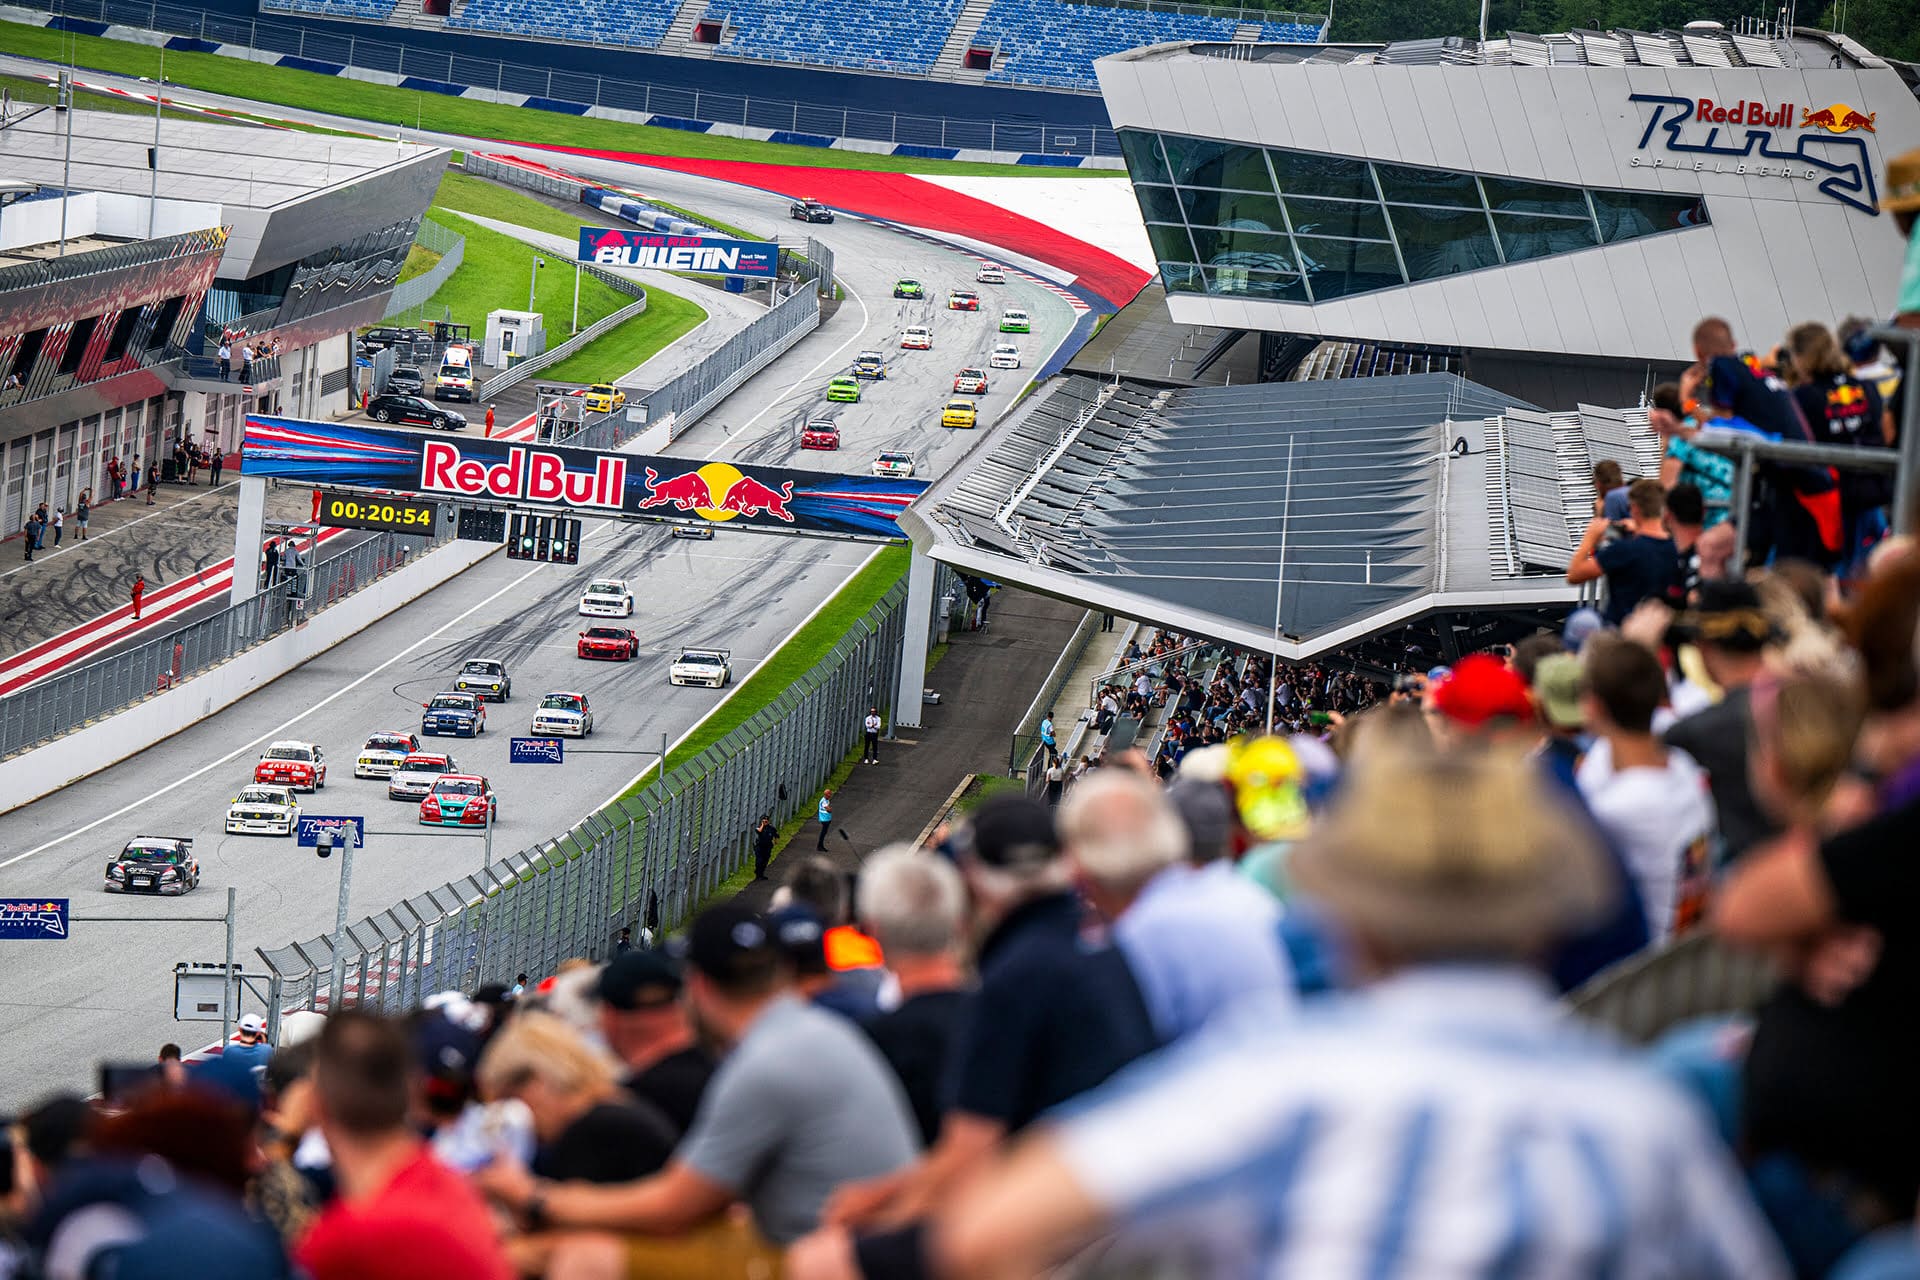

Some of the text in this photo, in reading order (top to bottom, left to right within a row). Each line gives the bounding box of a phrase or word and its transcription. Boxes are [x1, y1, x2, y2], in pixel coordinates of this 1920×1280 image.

[1696, 98, 1794, 128] Red Bull
[1630, 156, 1817, 180] SPIELBERG
[632, 236, 702, 248] THE RED
[421, 440, 627, 509] Red Bull
[331, 501, 431, 526] 00:20:54
